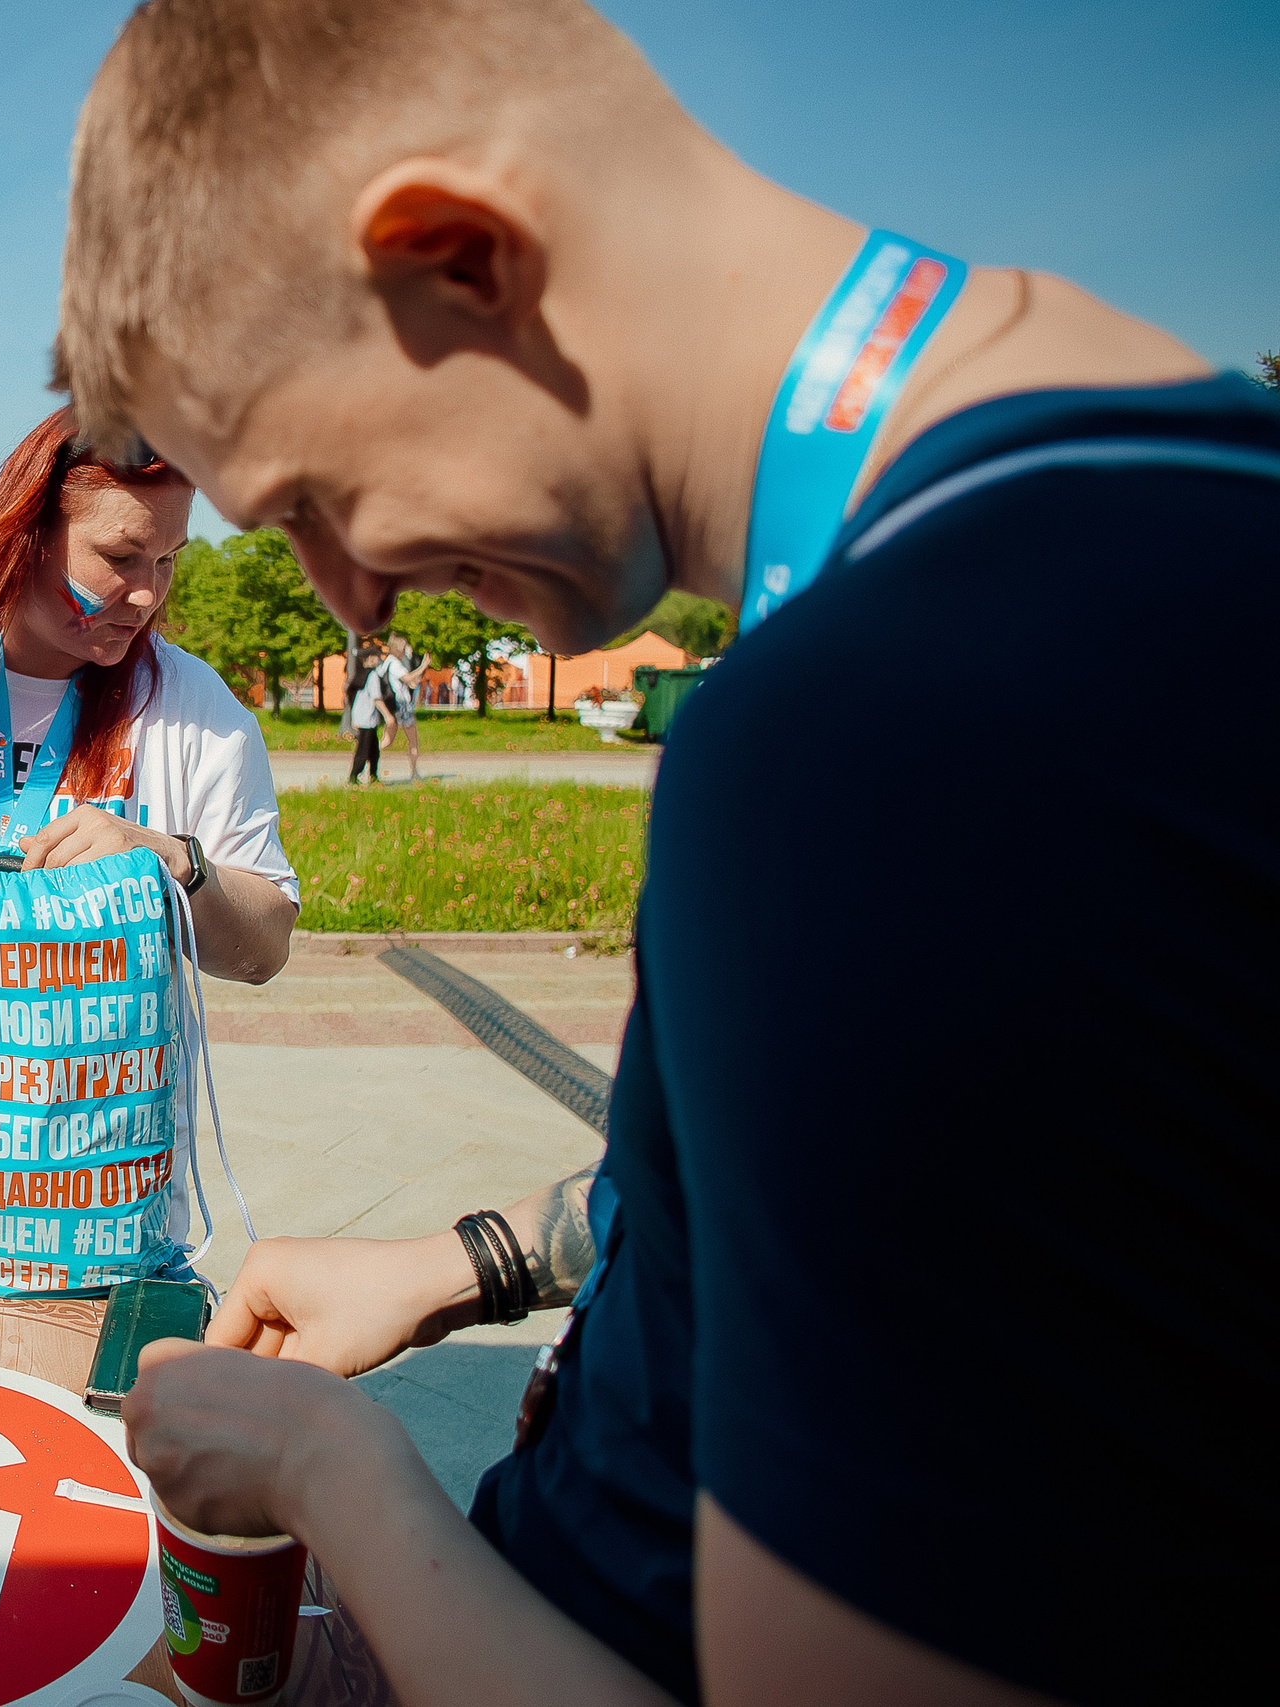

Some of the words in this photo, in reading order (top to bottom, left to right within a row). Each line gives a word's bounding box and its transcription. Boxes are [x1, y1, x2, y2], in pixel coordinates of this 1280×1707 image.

[32, 875, 163, 930] #СТРЕСС
[80, 994, 133, 1044] БЕГ
[140, 991, 158, 1036] В
[183, 1575, 214, 1593] мамы
